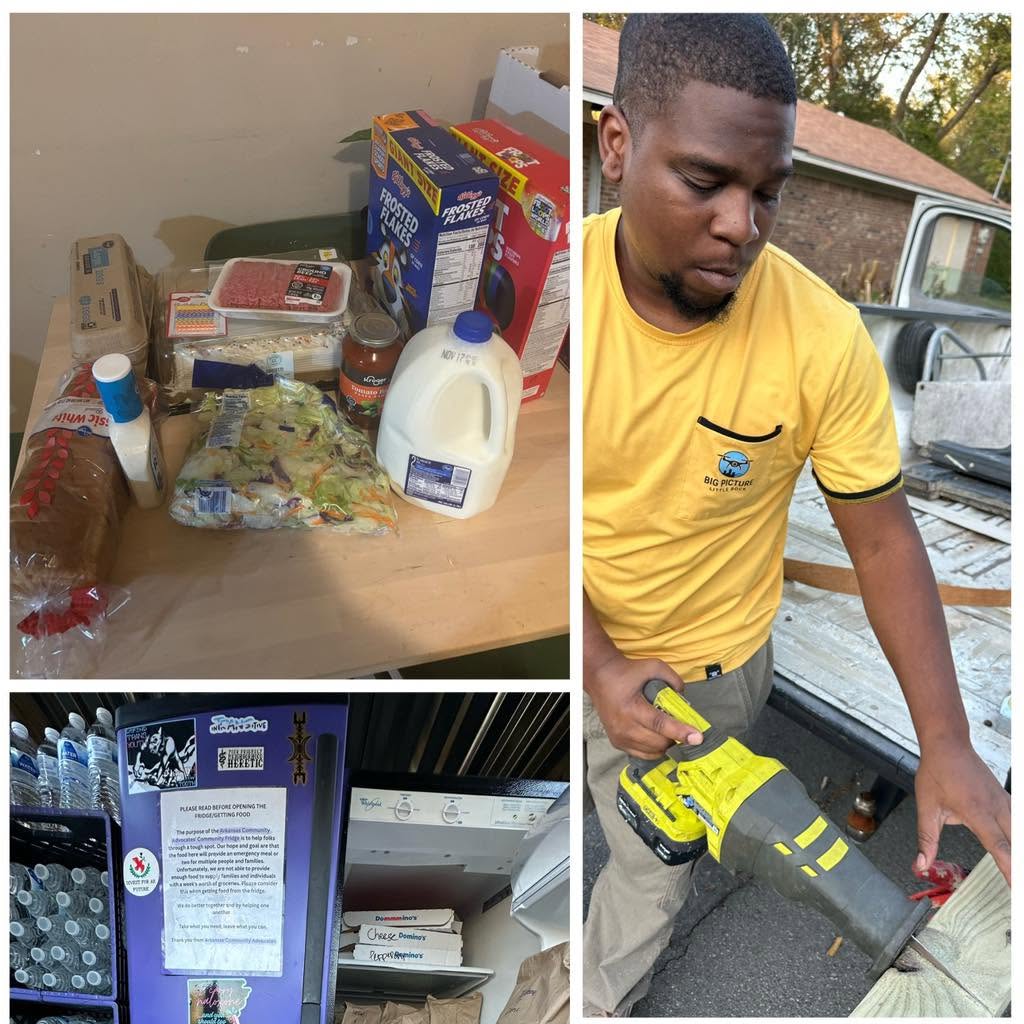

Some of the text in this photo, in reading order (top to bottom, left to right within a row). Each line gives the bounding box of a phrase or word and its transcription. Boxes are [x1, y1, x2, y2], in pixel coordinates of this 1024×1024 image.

[390, 143, 438, 208] GIANT SIZE
[380, 188, 418, 234] FROSTED
[442, 196, 491, 218] FROSTED
[443, 206, 485, 226] FLAKES
[380, 206, 412, 248] FLAKES
[441, 350, 466, 361] NOV 17
[704, 476, 718, 487] BIG
[228, 759, 263, 768] HERETIC
[367, 927, 400, 941] Cheese
[399, 932, 426, 941] Domino's
